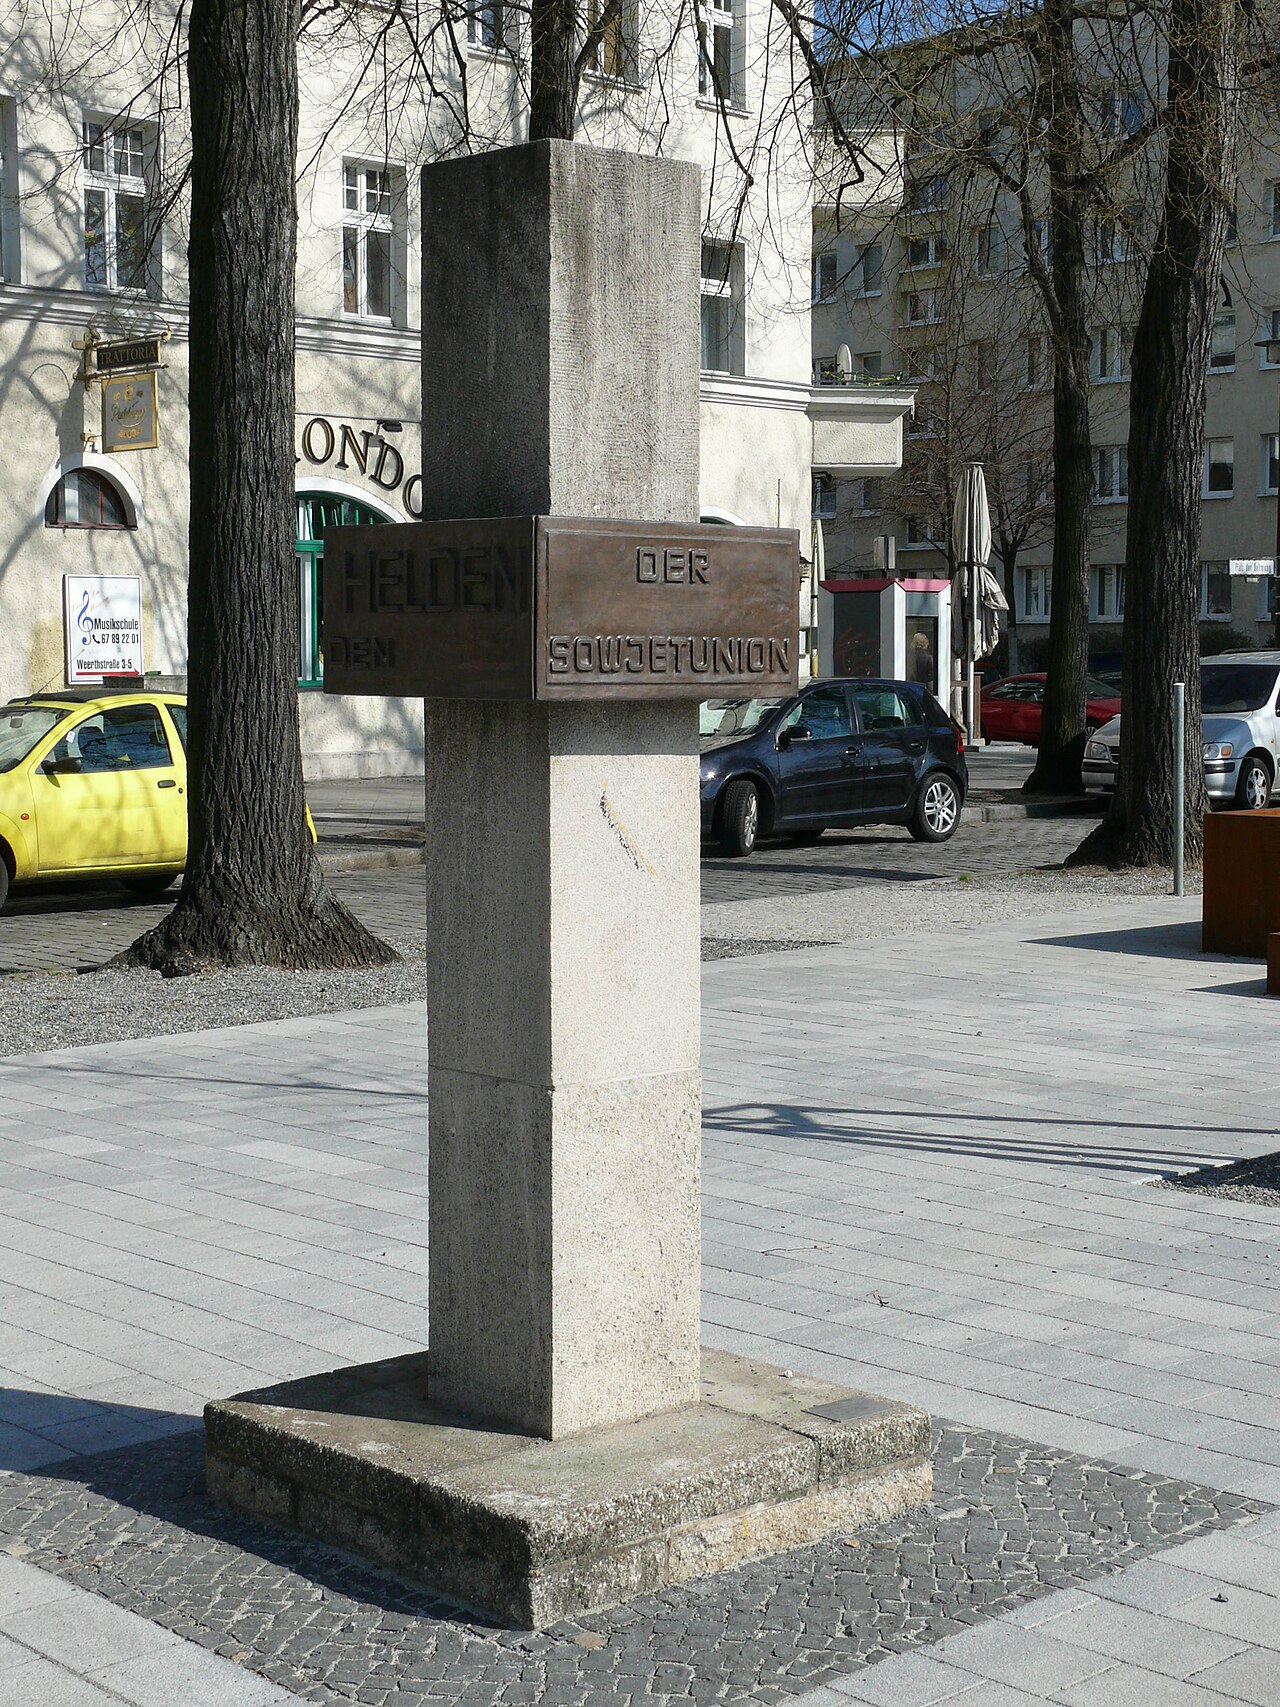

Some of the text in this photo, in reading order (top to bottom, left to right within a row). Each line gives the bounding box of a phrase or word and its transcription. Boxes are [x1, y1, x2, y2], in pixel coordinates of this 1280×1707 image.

[100, 346, 156, 364] TRATTORIA
[295, 417, 422, 520] ONDO
[343, 545, 529, 614] HELDEN
[636, 545, 711, 584] DER
[94, 617, 139, 630] Musikschule
[101, 633, 139, 644] 67 89 22 01
[77, 658, 133, 670] Weerthstraße 3-5
[329, 635, 396, 670] DEN
[549, 635, 791, 674] SOWJETUNION
